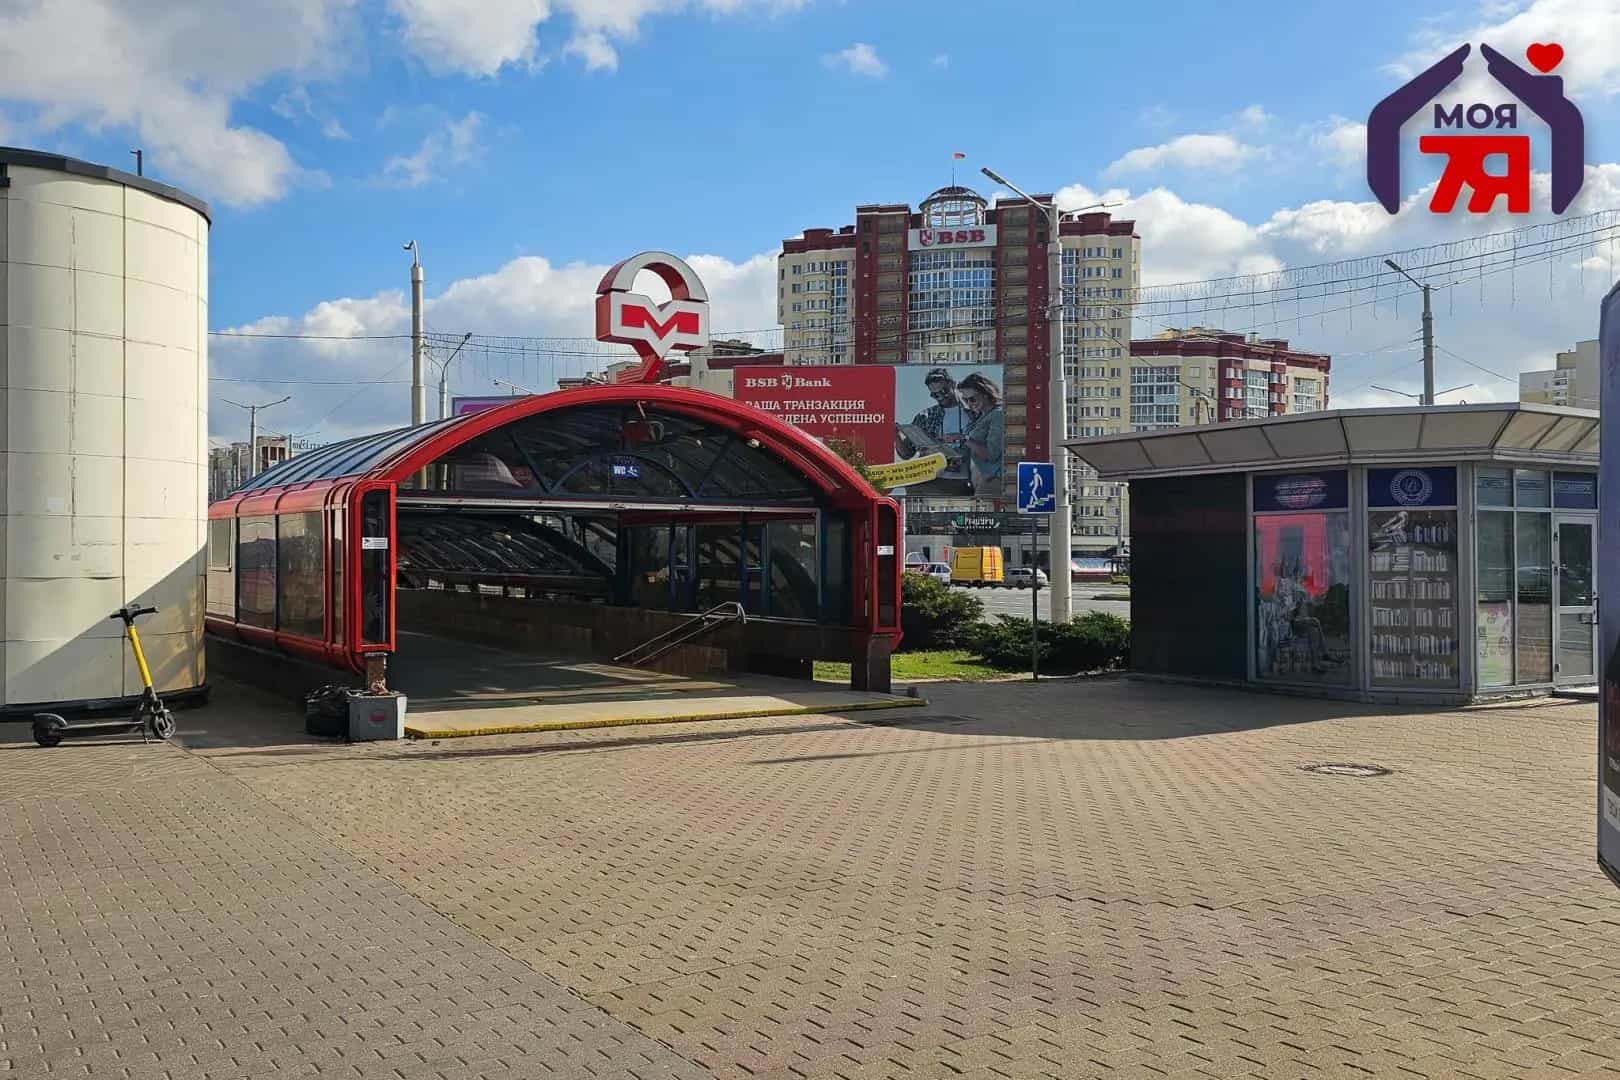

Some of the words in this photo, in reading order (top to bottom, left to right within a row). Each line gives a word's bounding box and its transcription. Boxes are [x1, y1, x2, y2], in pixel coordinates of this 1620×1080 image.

[937, 228, 986, 245] BSB
[745, 377, 779, 388] BSB
[794, 377, 832, 388] Bank
[783, 399, 865, 411] ТРАНЗАКЦИЯ
[820, 413, 885, 424] УСПЕШНО!
[613, 465, 626, 475] WC
